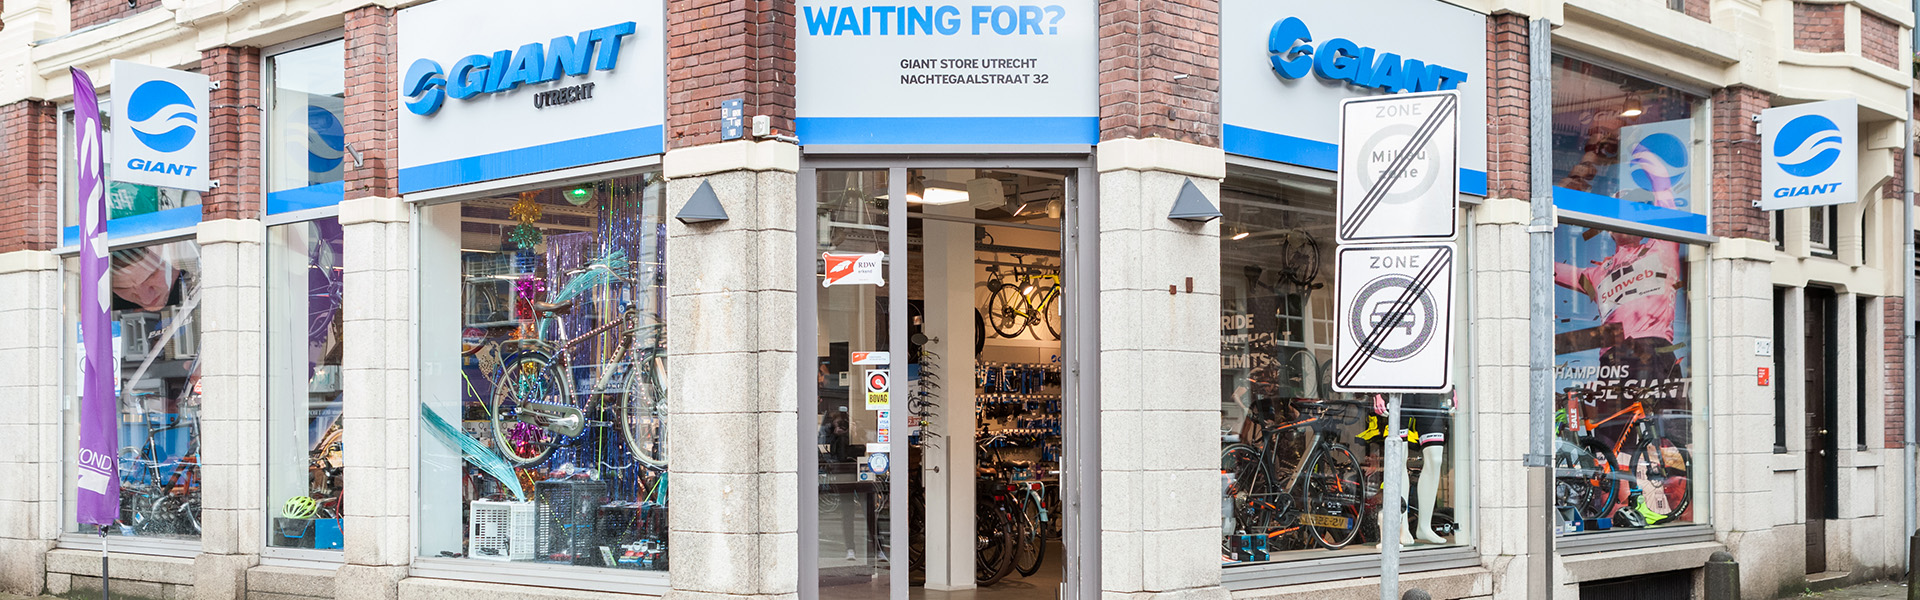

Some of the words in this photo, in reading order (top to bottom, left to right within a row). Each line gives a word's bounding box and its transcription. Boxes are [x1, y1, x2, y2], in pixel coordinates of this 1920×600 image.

[803, 5, 961, 36] WAITING
[971, 5, 1066, 36] FOR?
[446, 21, 636, 100] GIANT
[900, 58, 936, 70] GIANT
[940, 58, 979, 70] STORE
[982, 58, 1037, 70] UTRECHT
[1313, 37, 1469, 94] GIANT
[900, 73, 1030, 85] NACHTEGAALSTRAAT
[1033, 73, 1049, 85] 32
[533, 82, 596, 109] UTRECHT
[1375, 103, 1422, 119] ZONE
[1372, 149, 1426, 163] Milu
[127, 158, 198, 177] GIANT
[1773, 182, 1843, 199] GIANT
[1370, 255, 1420, 269] ZONE
[1601, 269, 1654, 304] sunweb
[1220, 313, 1255, 330] RIDE
[1221, 352, 1269, 369] LIMITS
[1555, 364, 1630, 379] HAMPIONS
[1622, 378, 1693, 400] GIANT
[869, 394, 888, 403] BOVAG
